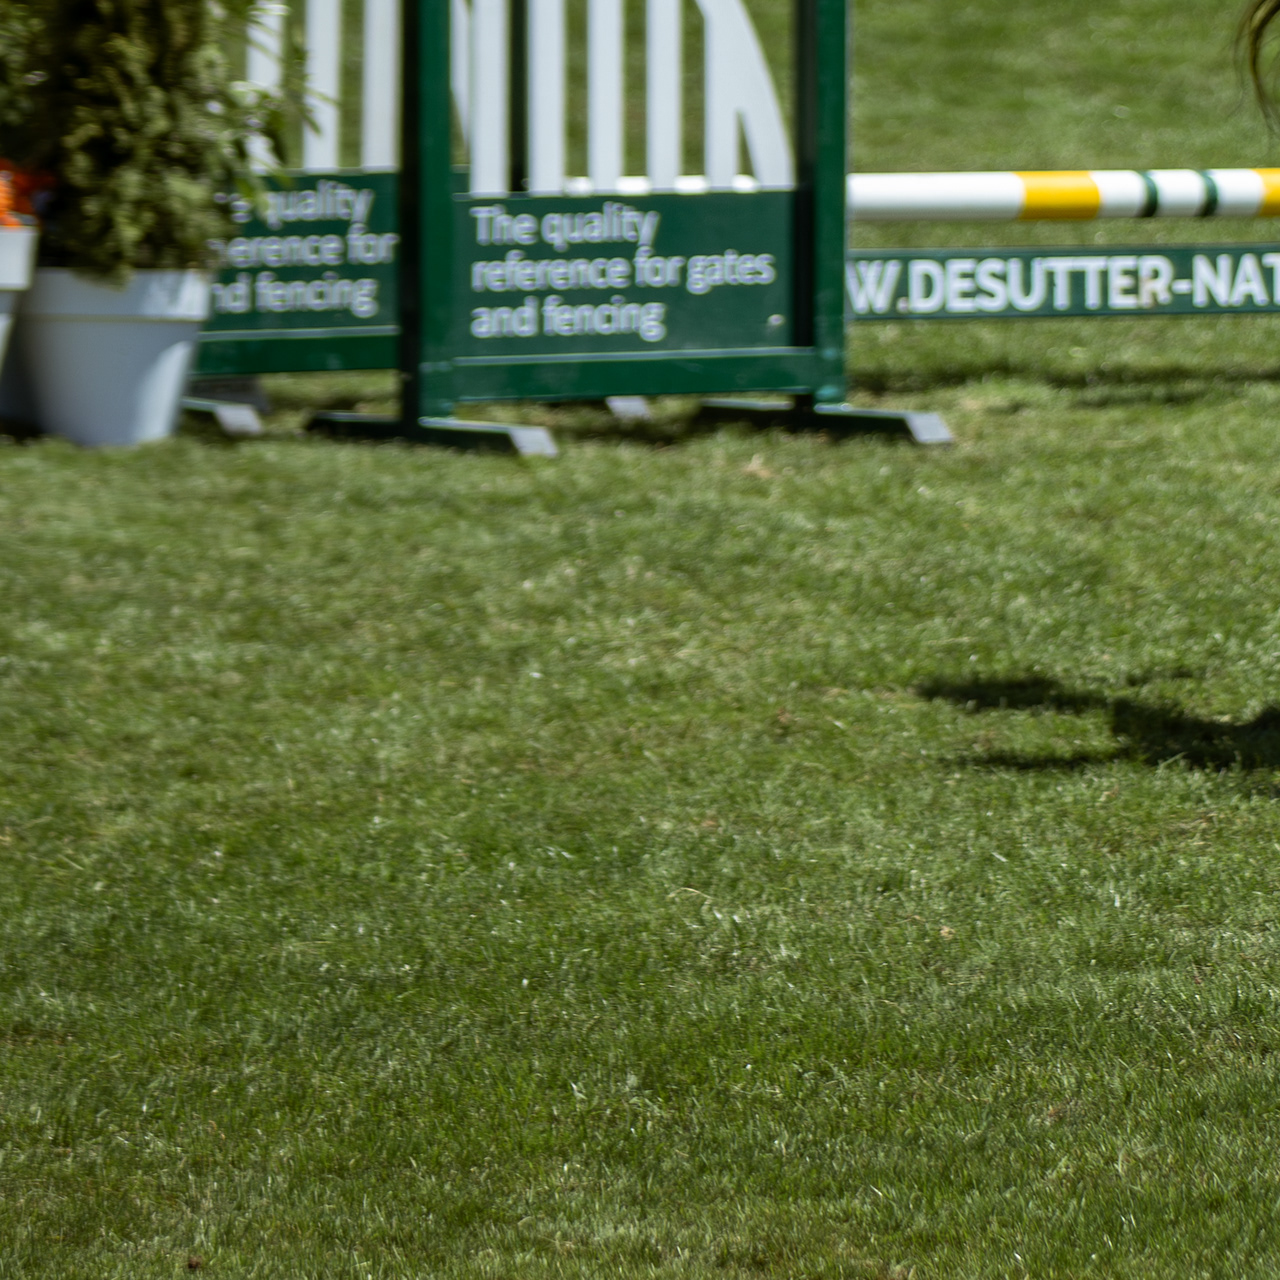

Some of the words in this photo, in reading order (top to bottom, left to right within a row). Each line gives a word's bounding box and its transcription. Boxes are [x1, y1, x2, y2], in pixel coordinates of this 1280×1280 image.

[469, 203, 538, 245] The
[541, 201, 661, 250] quality
[208, 234, 345, 268] erence
[471, 250, 631, 292] reference
[633, 245, 686, 287] for
[686, 249, 776, 295] gates
[210, 272, 252, 313] nd
[255, 271, 379, 318] fencing
[470, 295, 539, 339] and
[542, 294, 667, 342] fencing
